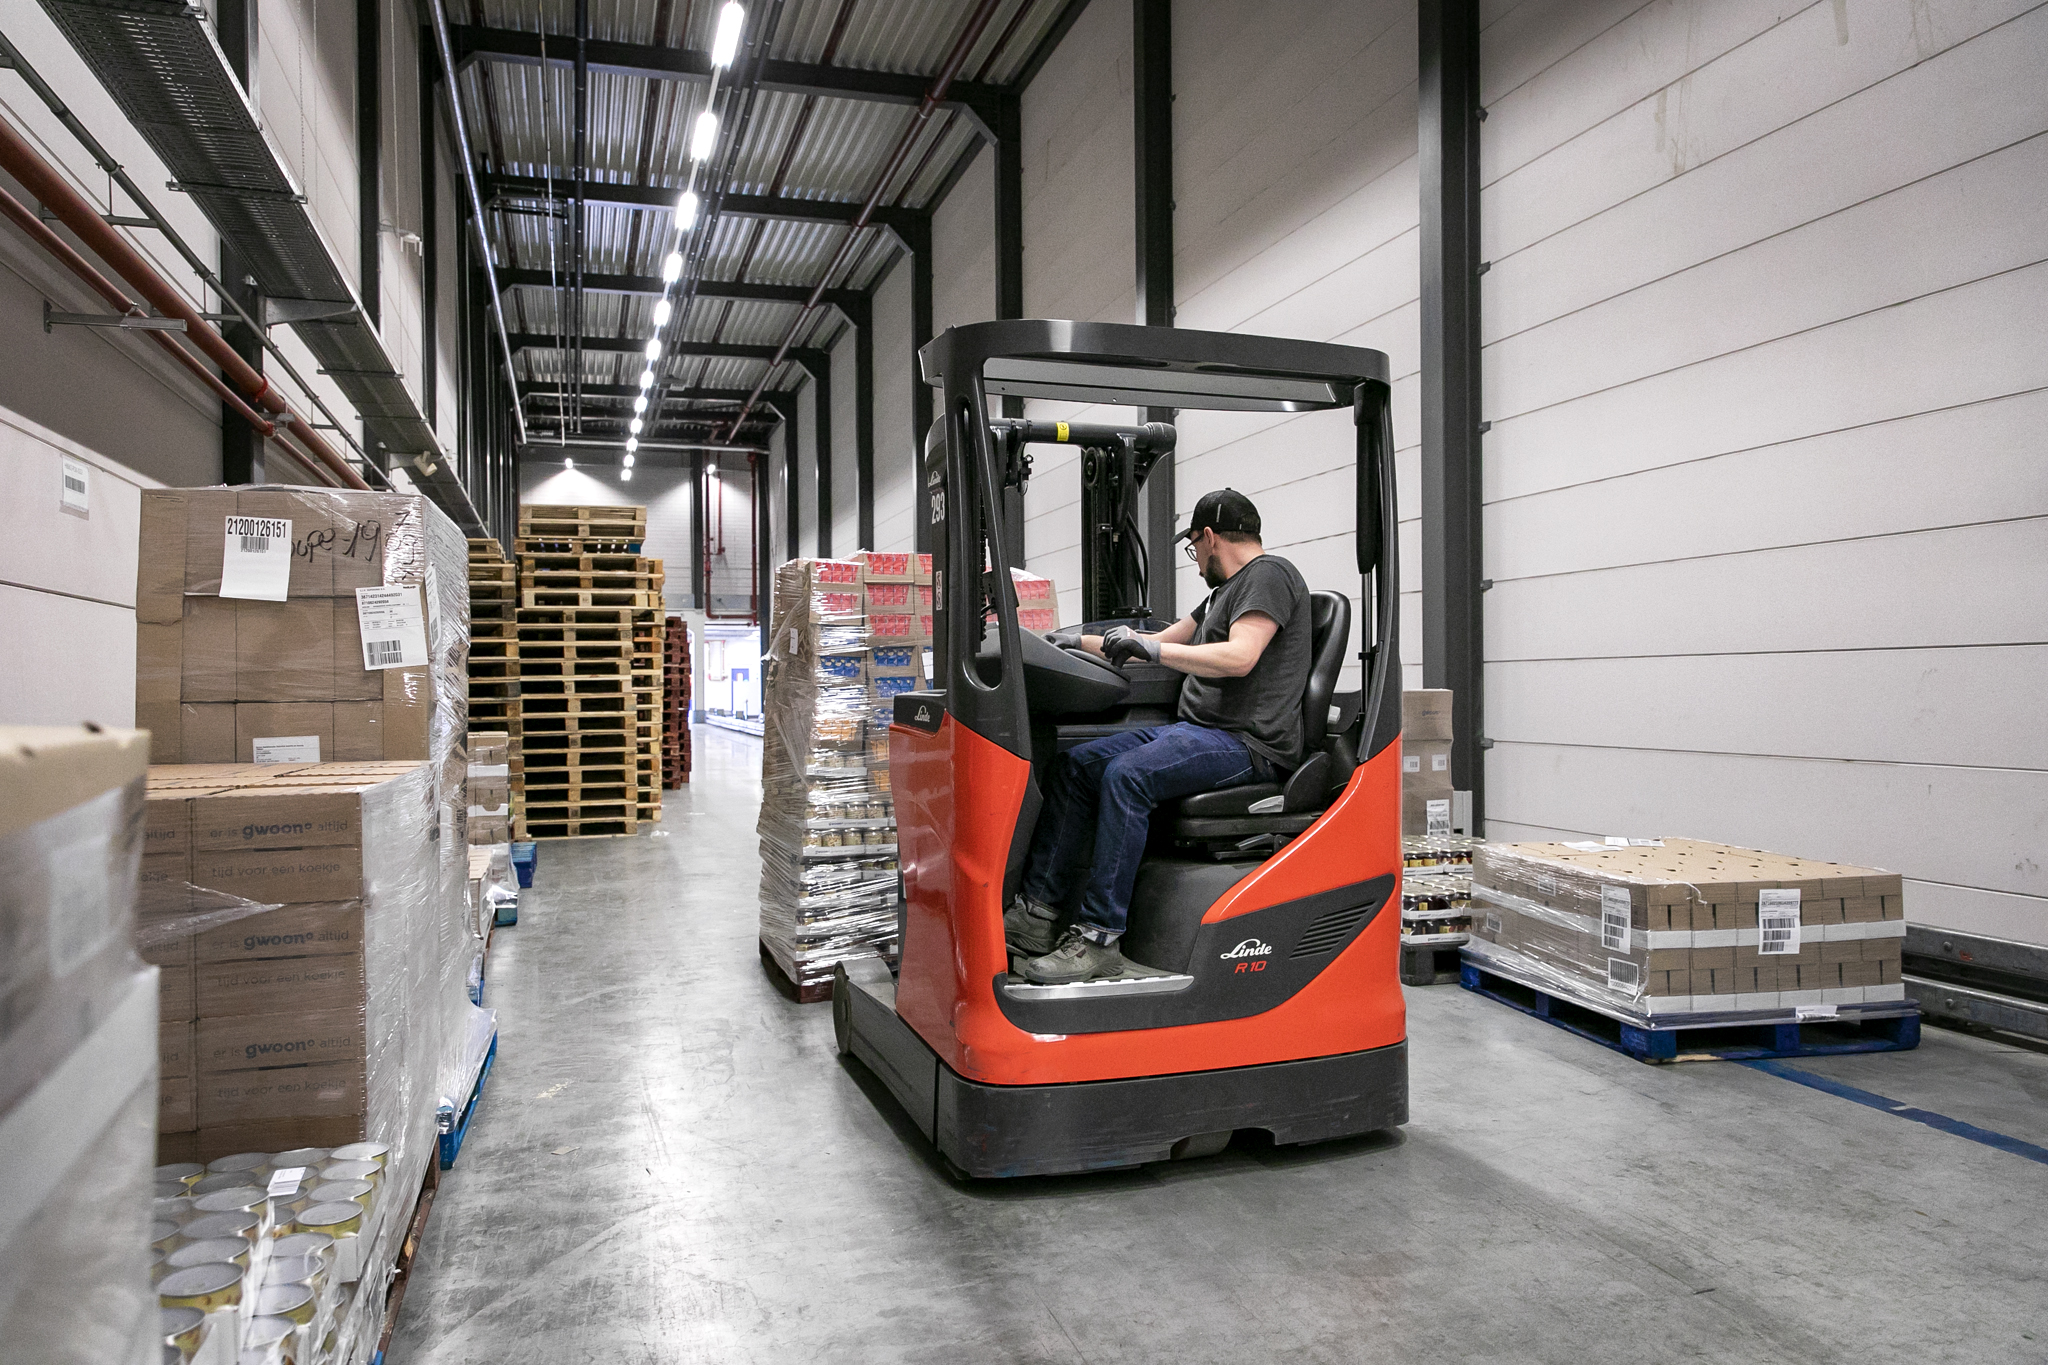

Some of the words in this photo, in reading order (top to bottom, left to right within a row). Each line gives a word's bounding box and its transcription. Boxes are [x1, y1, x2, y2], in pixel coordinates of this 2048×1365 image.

[931, 491, 945, 524] 293
[227, 517, 287, 538] 21200126151
[914, 705, 930, 722] Linde
[210, 829, 223, 838] er
[227, 827, 237, 837] is
[317, 820, 348, 833] altijd
[212, 866, 233, 878] tijd
[237, 866, 267, 877] voor
[271, 865, 294, 875] een
[299, 862, 340, 875] koekje
[318, 930, 349, 943] altijd
[1220, 938, 1272, 959] Linde
[1234, 962, 1248, 974] R
[1250, 960, 1267, 972] 10
[217, 976, 238, 988] tijd
[243, 975, 273, 985] voor
[276, 973, 300, 983] een
[303, 970, 346, 983] koekje
[213, 1049, 226, 1058] er
[230, 1047, 241, 1057] is
[319, 1037, 351, 1050] altijd
[217, 1086, 239, 1099] tijd
[243, 1085, 273, 1095] voor
[277, 1083, 300, 1093] een
[304, 1078, 346, 1093] koekje
